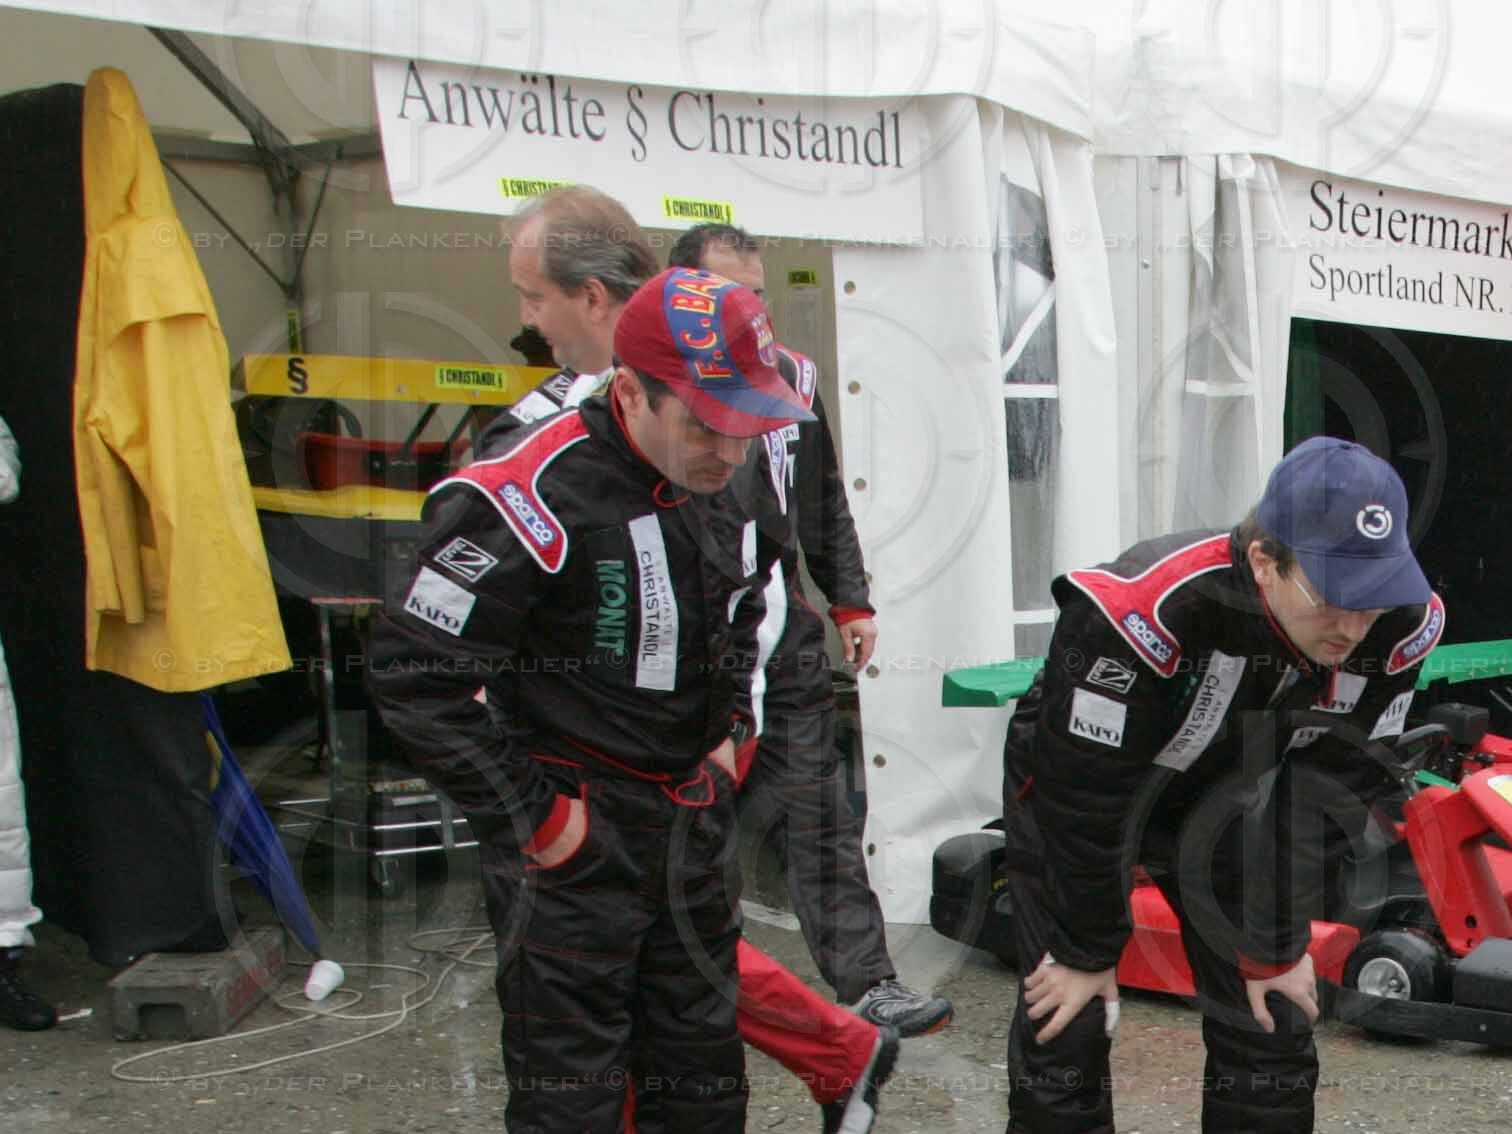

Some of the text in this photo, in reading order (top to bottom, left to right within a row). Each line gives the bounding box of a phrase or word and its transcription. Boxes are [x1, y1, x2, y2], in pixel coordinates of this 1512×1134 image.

[397, 59, 607, 142] Anwälte
[668, 90, 905, 169] Christandl
[1308, 253, 1444, 304] Sportland
[501, 484, 553, 546] sparco
[409, 596, 460, 630] KAPO
[640, 551, 660, 662] CHRISTANDL
[1123, 613, 1172, 664] sparco
[1073, 717, 1120, 744] KAPO
